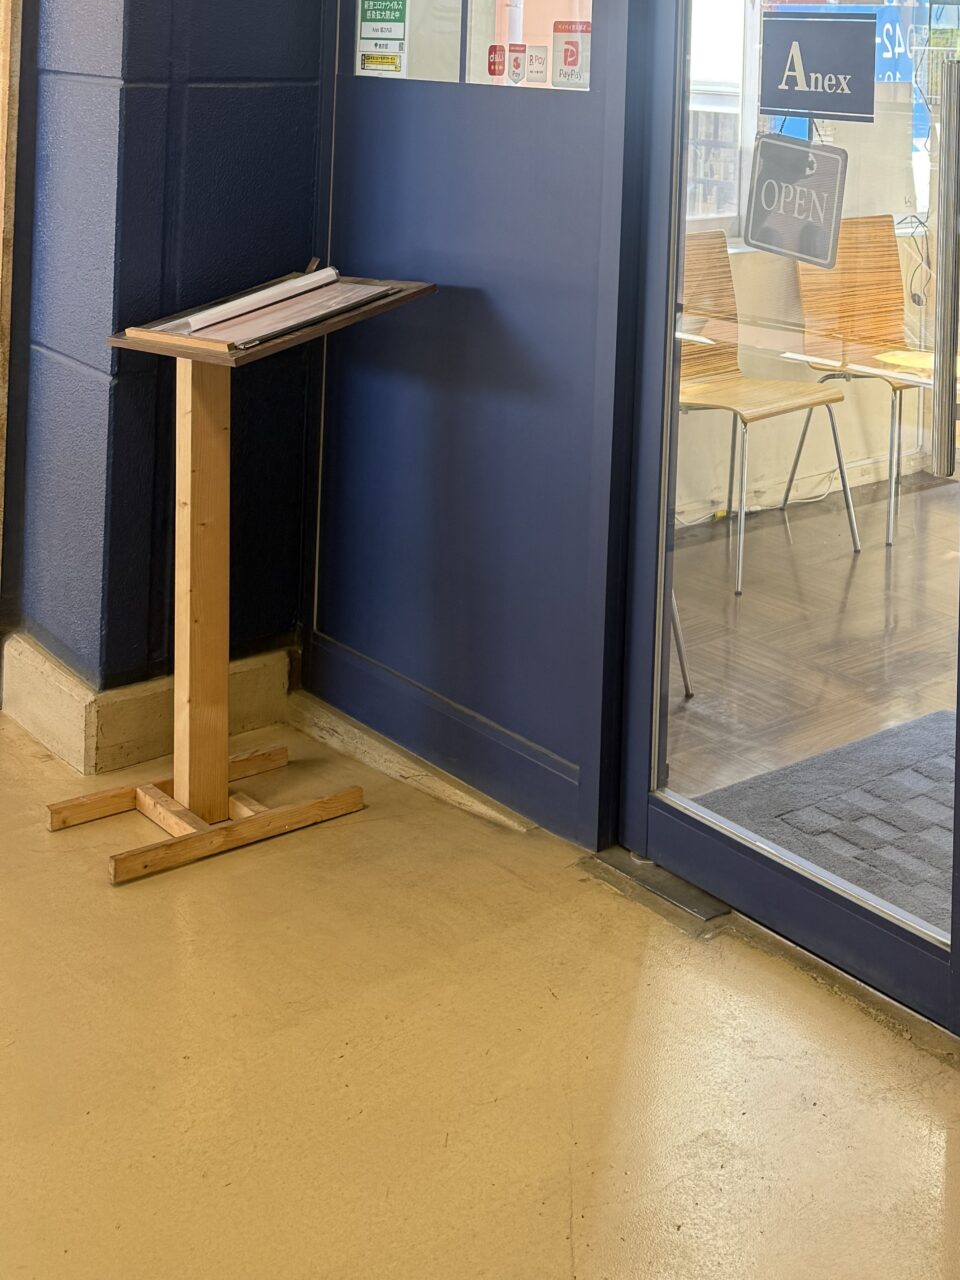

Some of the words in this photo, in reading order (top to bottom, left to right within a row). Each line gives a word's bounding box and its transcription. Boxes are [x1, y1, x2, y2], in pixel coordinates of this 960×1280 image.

[559, 69, 582, 81] PayPay
[778, 40, 852, 95] Anex
[761, 178, 828, 225] OPEN
